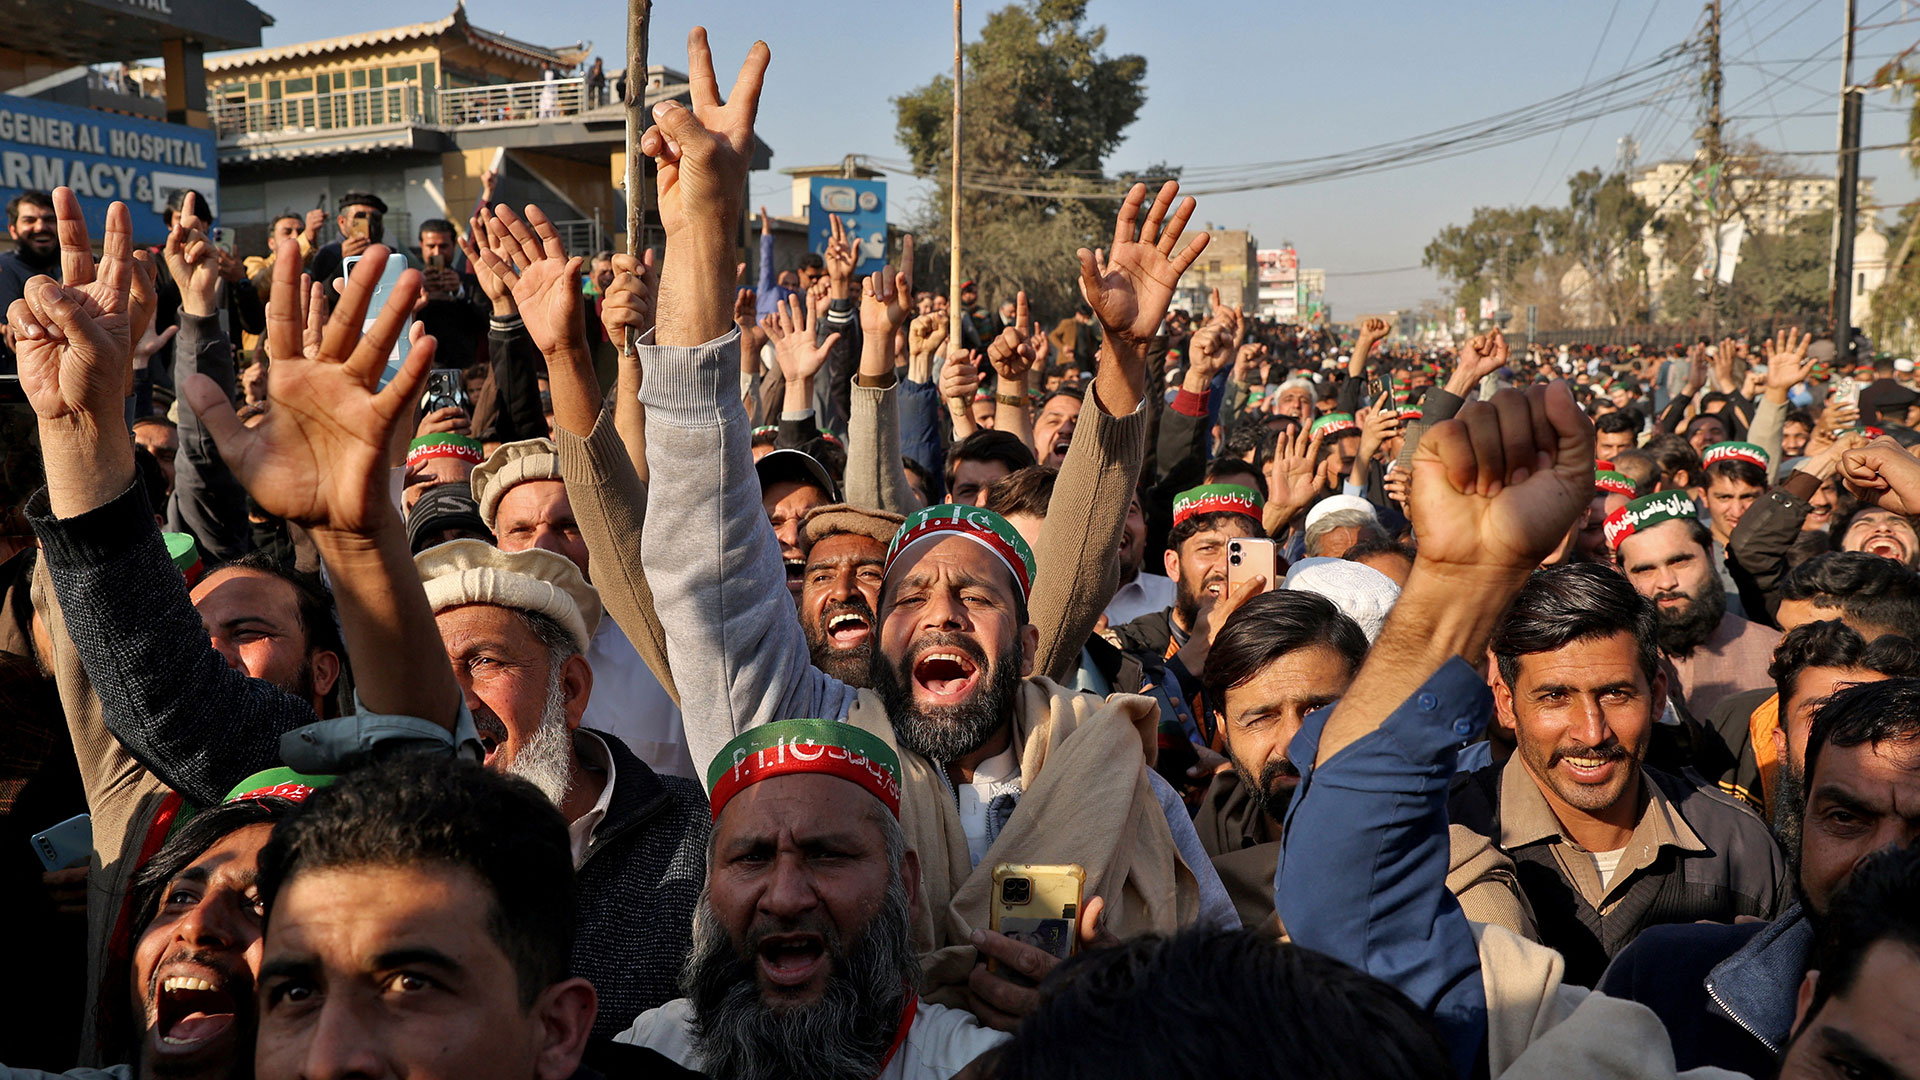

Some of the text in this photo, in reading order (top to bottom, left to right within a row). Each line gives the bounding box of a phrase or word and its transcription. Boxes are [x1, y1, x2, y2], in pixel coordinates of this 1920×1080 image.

[0, 110, 207, 169] GENERAL HOSPITAL
[0, 151, 152, 202] RMACY&
